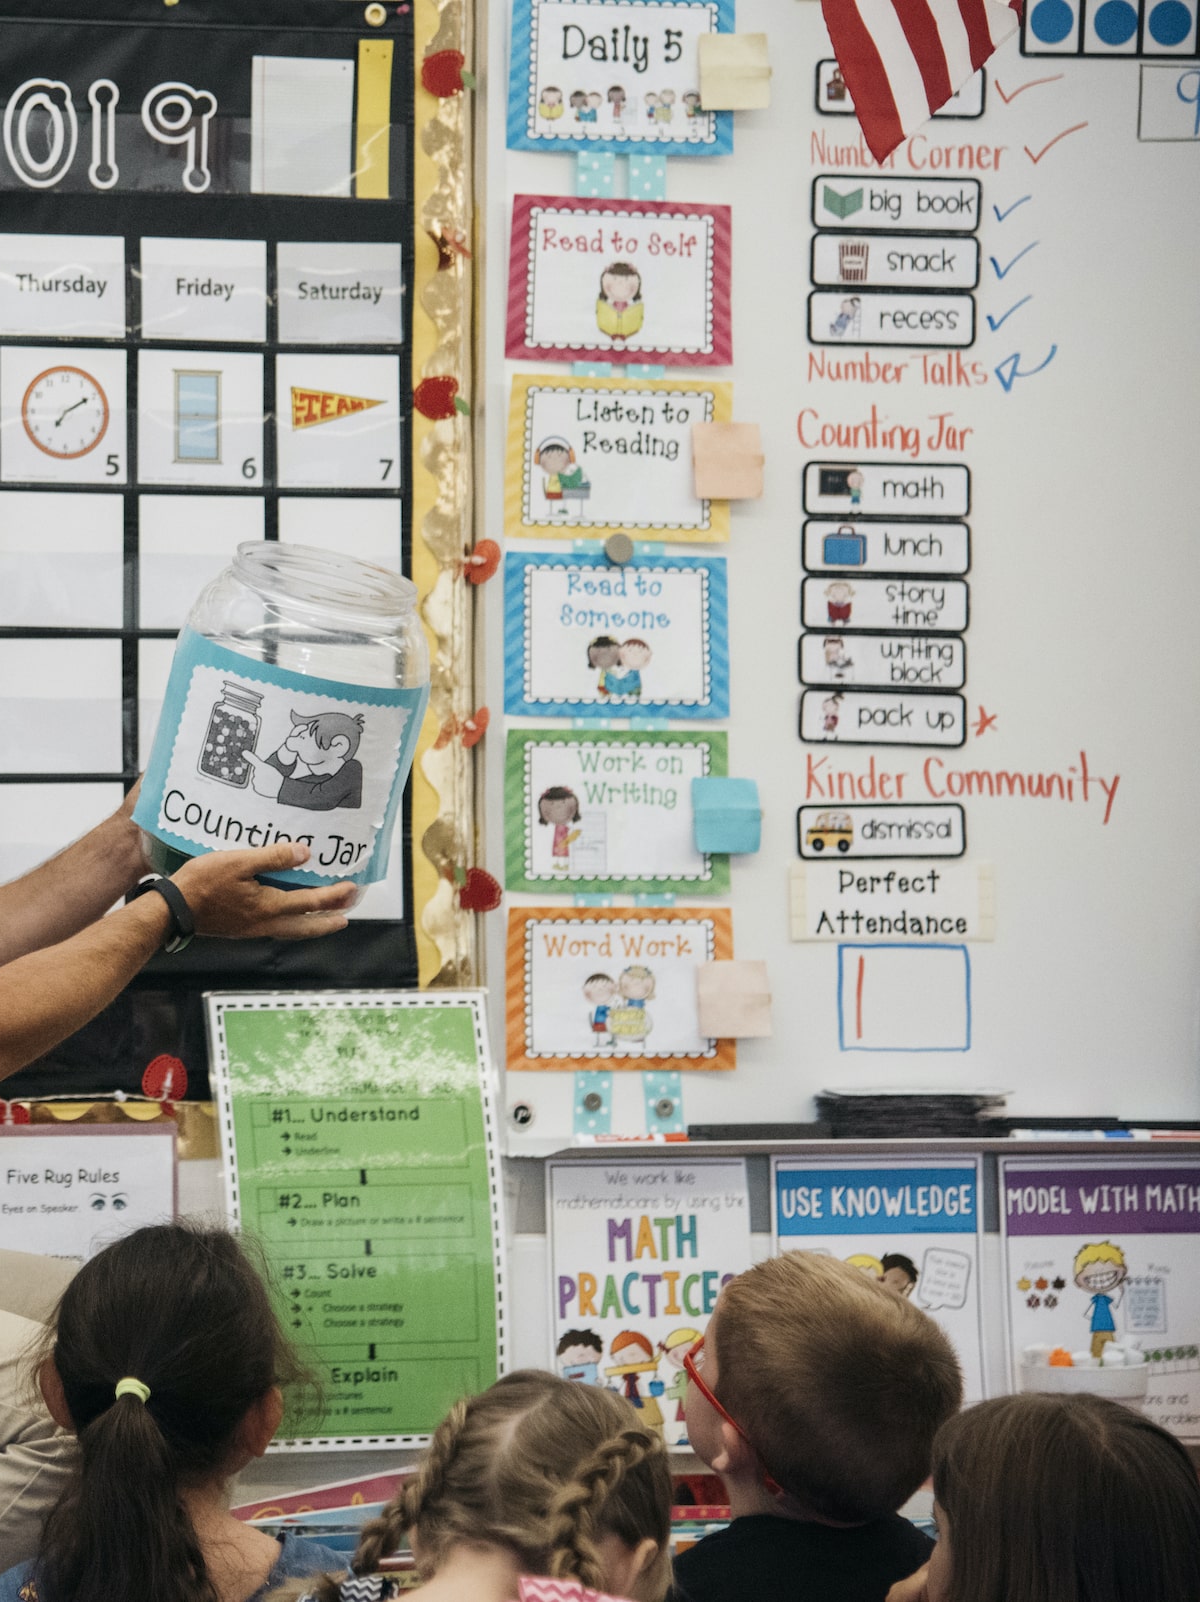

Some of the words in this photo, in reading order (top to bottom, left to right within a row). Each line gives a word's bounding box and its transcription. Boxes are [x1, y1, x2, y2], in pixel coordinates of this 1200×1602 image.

[562, 25, 648, 73] Daily
[664, 28, 683, 62] 5
[810, 127, 896, 170] Numbr
[906, 133, 1009, 171] Corner
[870, 190, 902, 220] big
[916, 191, 974, 214] book
[542, 228, 605, 254] Read
[611, 230, 638, 253] to
[647, 232, 697, 257] Self
[887, 250, 957, 273] snack
[15, 273, 108, 298] Thursday
[175, 277, 235, 301] Friday
[297, 281, 384, 304] Saturday
[880, 309, 960, 330] recess
[807, 351, 908, 385] Number
[910, 352, 988, 387] Talks
[299, 392, 365, 424] TEAM
[576, 398, 655, 425] Listen
[661, 402, 690, 424] to
[797, 404, 921, 458] Counting
[926, 412, 974, 452] Jar
[583, 431, 680, 462] Reading
[106, 455, 120, 476] 5
[241, 457, 257, 479] 6
[378, 459, 394, 480] 7
[882, 475, 944, 499] math
[883, 532, 943, 557] lunch
[567, 573, 627, 598] Read
[634, 576, 663, 597] to
[885, 581, 945, 610] story
[560, 603, 671, 629] Someone
[892, 604, 939, 627] time
[881, 638, 954, 667] writing
[890, 662, 943, 684] block
[857, 702, 913, 729] pack
[927, 712, 955, 733] up
[577, 750, 647, 774] Work
[656, 755, 684, 775] on
[583, 780, 678, 810] Writing
[805, 753, 909, 801] Kinder
[923, 750, 1122, 825] Community
[861, 817, 953, 841] dismissal
[318, 834, 368, 866] Jar
[838, 868, 940, 894] Perfect
[815, 910, 968, 936] Attendance
[543, 933, 613, 958] Word
[620, 933, 693, 958] Work
[310, 1105, 420, 1124] Understand
[6, 1169, 40, 1185] Five
[45, 1169, 73, 1188] Rug
[78, 1168, 121, 1185] Rules
[634, 1170, 668, 1186] work
[1, 1203, 24, 1216] Eyes
[322, 1192, 361, 1208] Plan
[781, 1187, 824, 1220] USE
[830, 1184, 973, 1220] KNOWLEDGE
[1007, 1186, 1072, 1217] MODEL
[1079, 1186, 1139, 1215] WITH
[607, 1214, 698, 1262] MATH
[326, 1263, 378, 1280] Solve
[558, 1270, 736, 1320] PRACTICE
[331, 1366, 399, 1386] Explain
